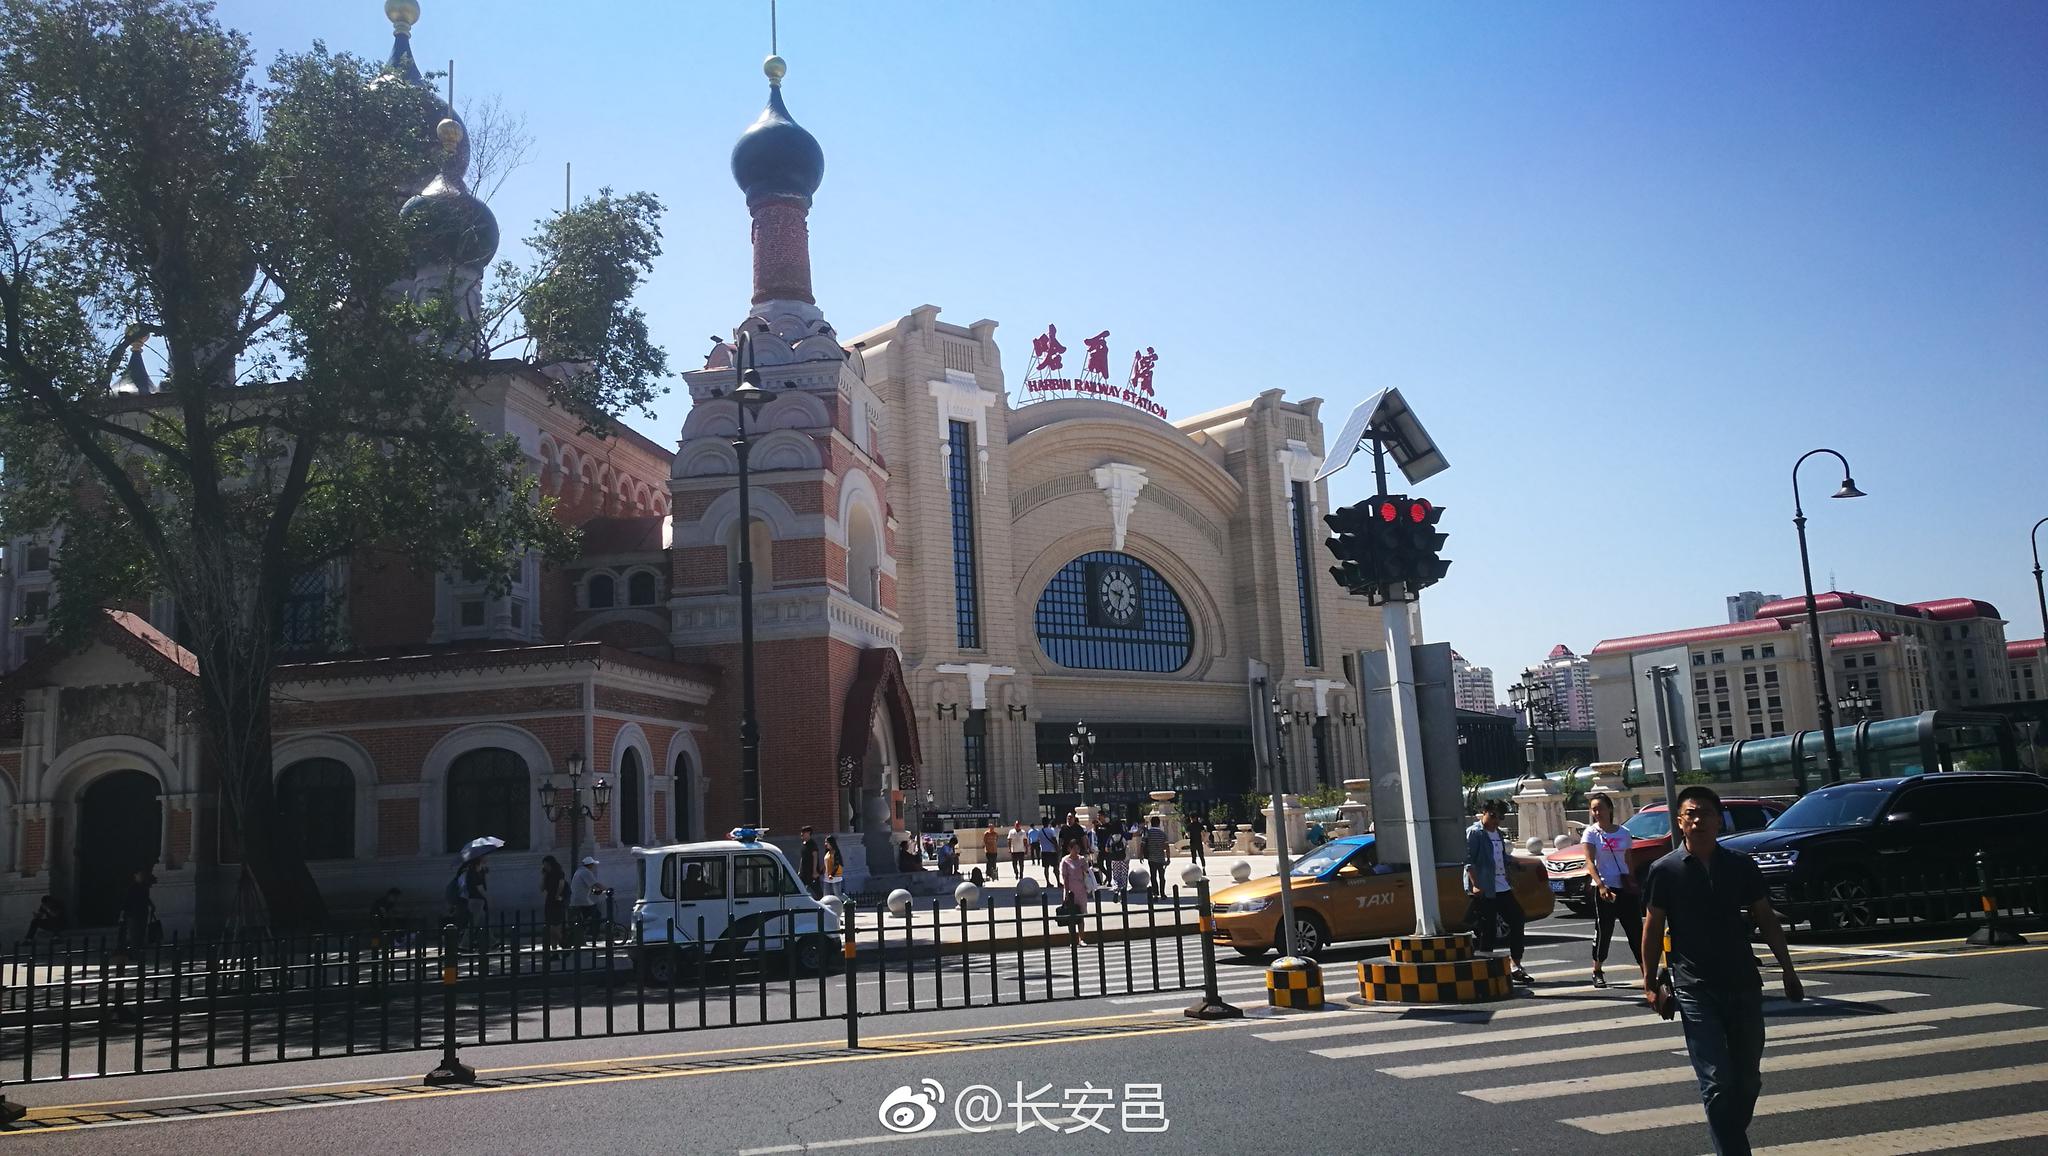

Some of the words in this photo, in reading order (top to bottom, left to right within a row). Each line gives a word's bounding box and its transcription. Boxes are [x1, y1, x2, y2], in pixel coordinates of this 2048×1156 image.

[1027, 379, 1072, 392] HARBIN
[1074, 379, 1122, 398] RAILWAY
[1122, 389, 1168, 420] STATION
[1355, 892, 1394, 908] TAXI
